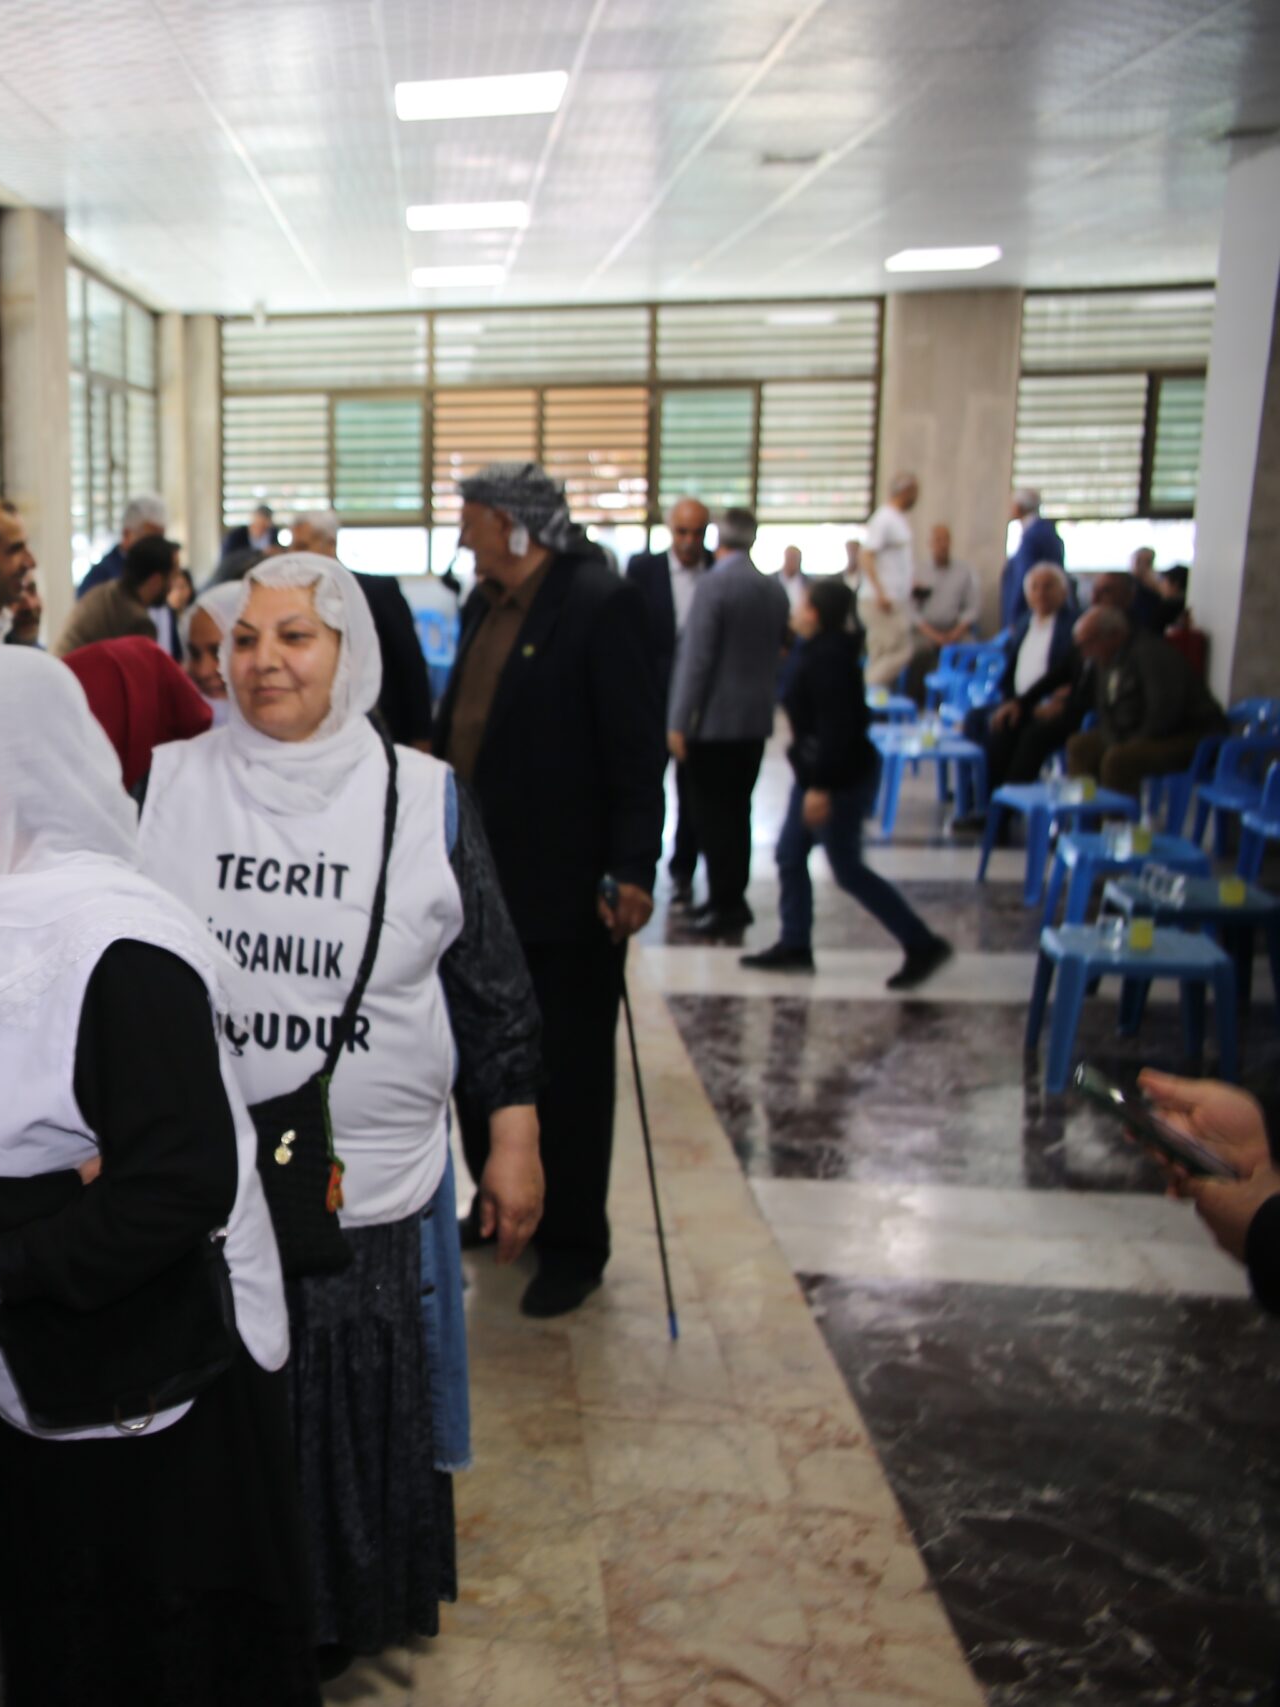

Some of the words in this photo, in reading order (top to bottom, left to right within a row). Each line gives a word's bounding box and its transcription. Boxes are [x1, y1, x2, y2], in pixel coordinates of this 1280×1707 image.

[217, 852, 350, 900] TECRİT
[207, 917, 344, 979] NSANLIK
[216, 1011, 370, 1057] ÇUDUR
